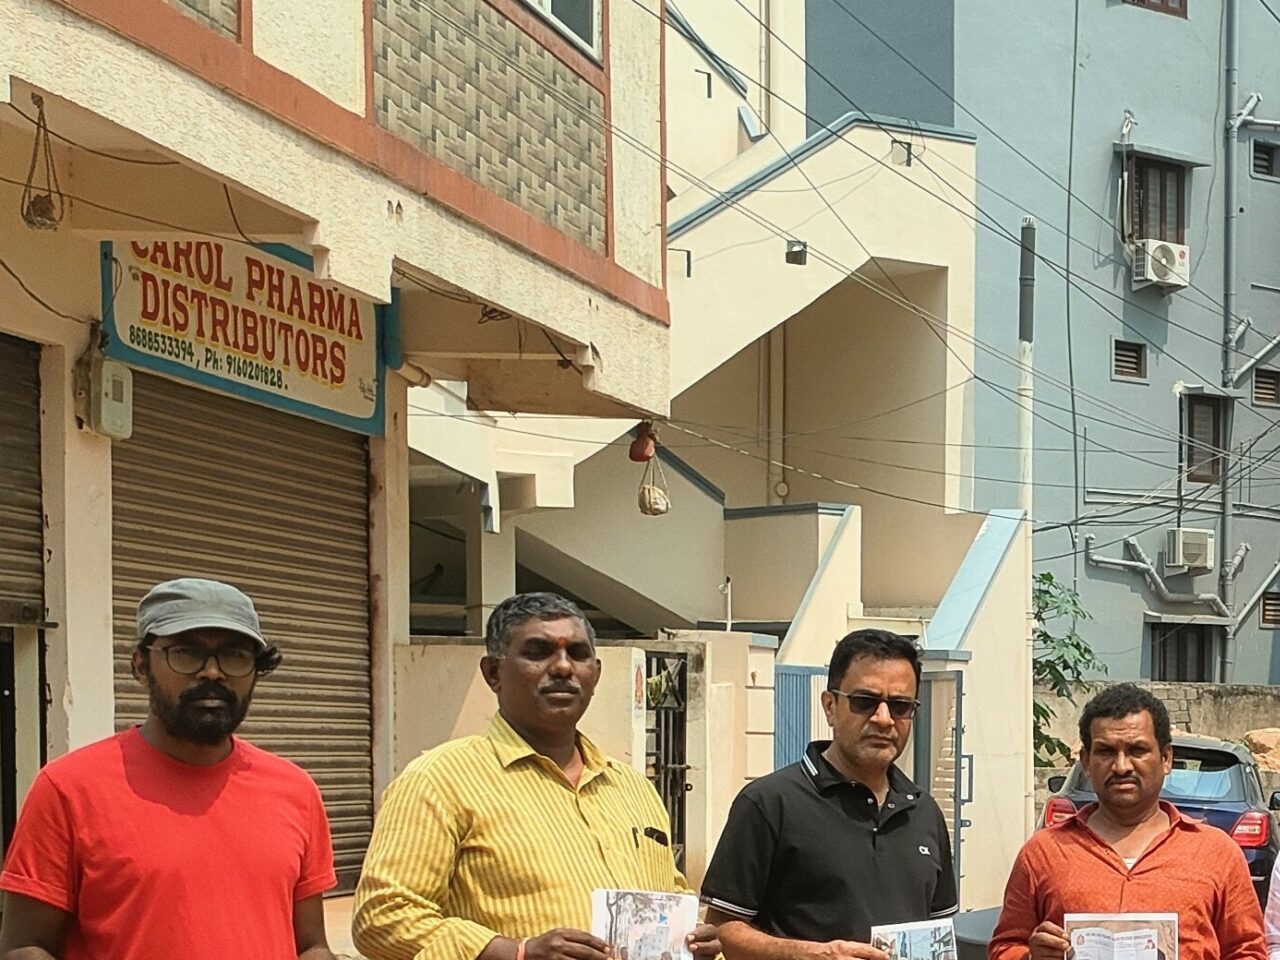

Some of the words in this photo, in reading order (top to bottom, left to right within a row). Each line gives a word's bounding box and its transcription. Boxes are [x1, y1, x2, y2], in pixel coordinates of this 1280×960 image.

[140, 269, 347, 385] DISTRIBUTORS
[245, 255, 363, 341] PHARMA
[204, 347, 224, 371] Ph:
